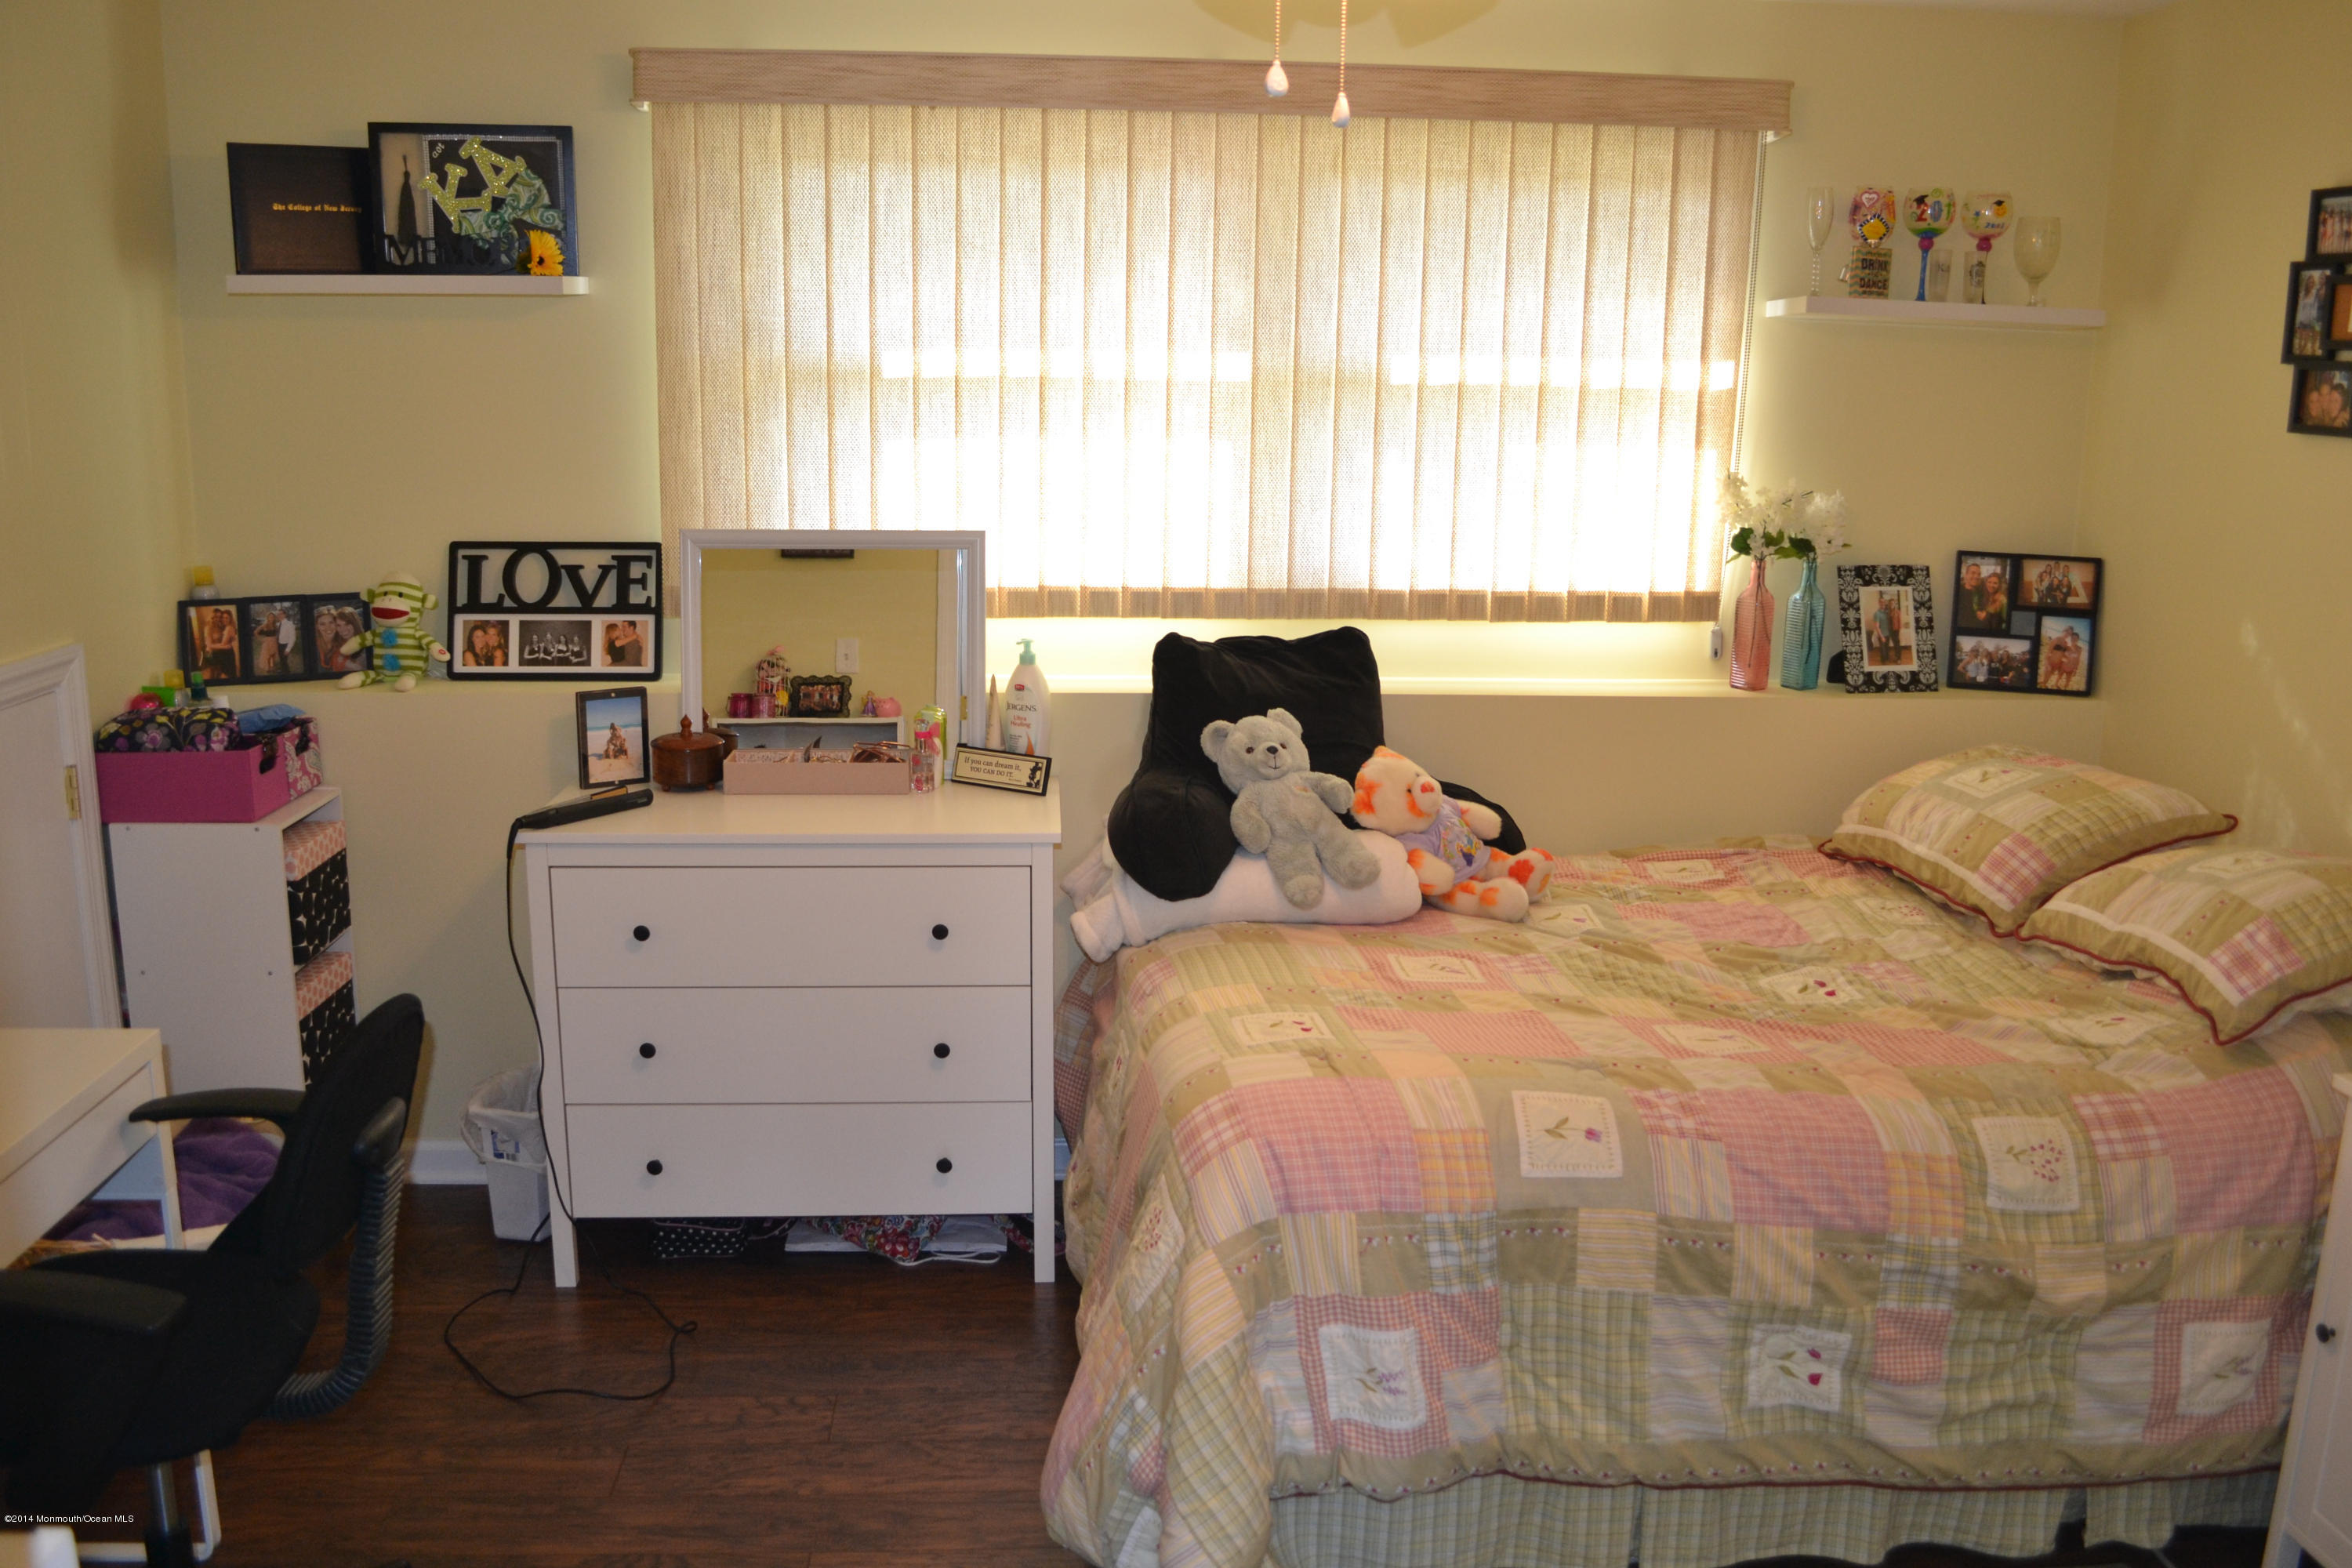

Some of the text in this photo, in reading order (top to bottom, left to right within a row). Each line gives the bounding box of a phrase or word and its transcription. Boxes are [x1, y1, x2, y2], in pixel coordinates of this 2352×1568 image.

[288, 204, 312, 212] College
[462, 549, 653, 608] LOVE
[1007, 701, 1036, 712] JERGENS
[994, 760, 1014, 770] dream
